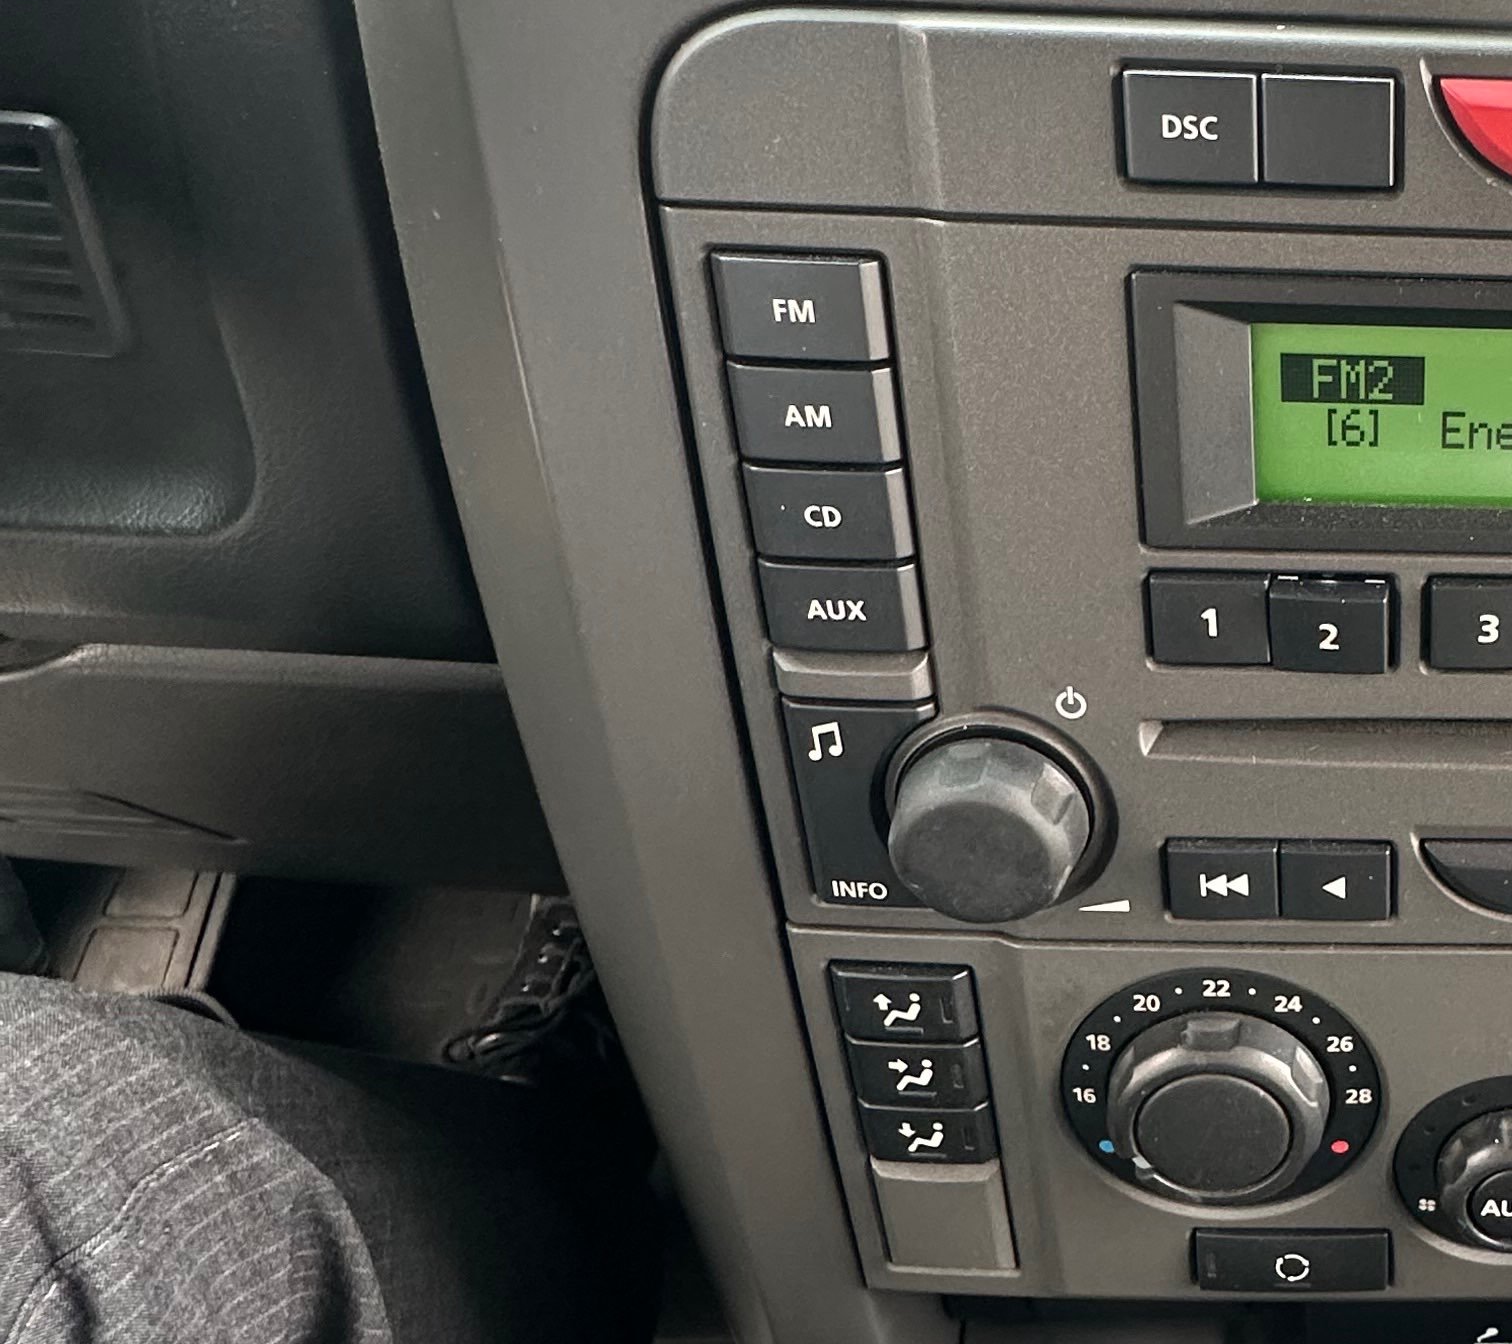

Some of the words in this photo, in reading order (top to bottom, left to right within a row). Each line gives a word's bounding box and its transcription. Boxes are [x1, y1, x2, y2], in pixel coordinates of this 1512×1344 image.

[1161, 113, 1219, 141] DSC
[772, 298, 816, 323] FM
[1311, 358, 1394, 401] FM2
[784, 404, 832, 428] AM
[1326, 408, 1380, 448] [6]
[803, 504, 842, 528] CD
[807, 599, 867, 621] AUX
[1200, 608, 1218, 637] 1
[1477, 613, 1500, 644] 3
[1318, 623, 1340, 650] 2
[831, 879, 888, 900] INFO
[1202, 979, 1231, 998] 22
[1132, 994, 1161, 1012] 20
[1274, 995, 1303, 1013] 24
[1085, 1033, 1111, 1052] 18
[1326, 1035, 1354, 1053] 26
[1072, 1087, 1097, 1104] 16
[1345, 1088, 1373, 1105] 28
